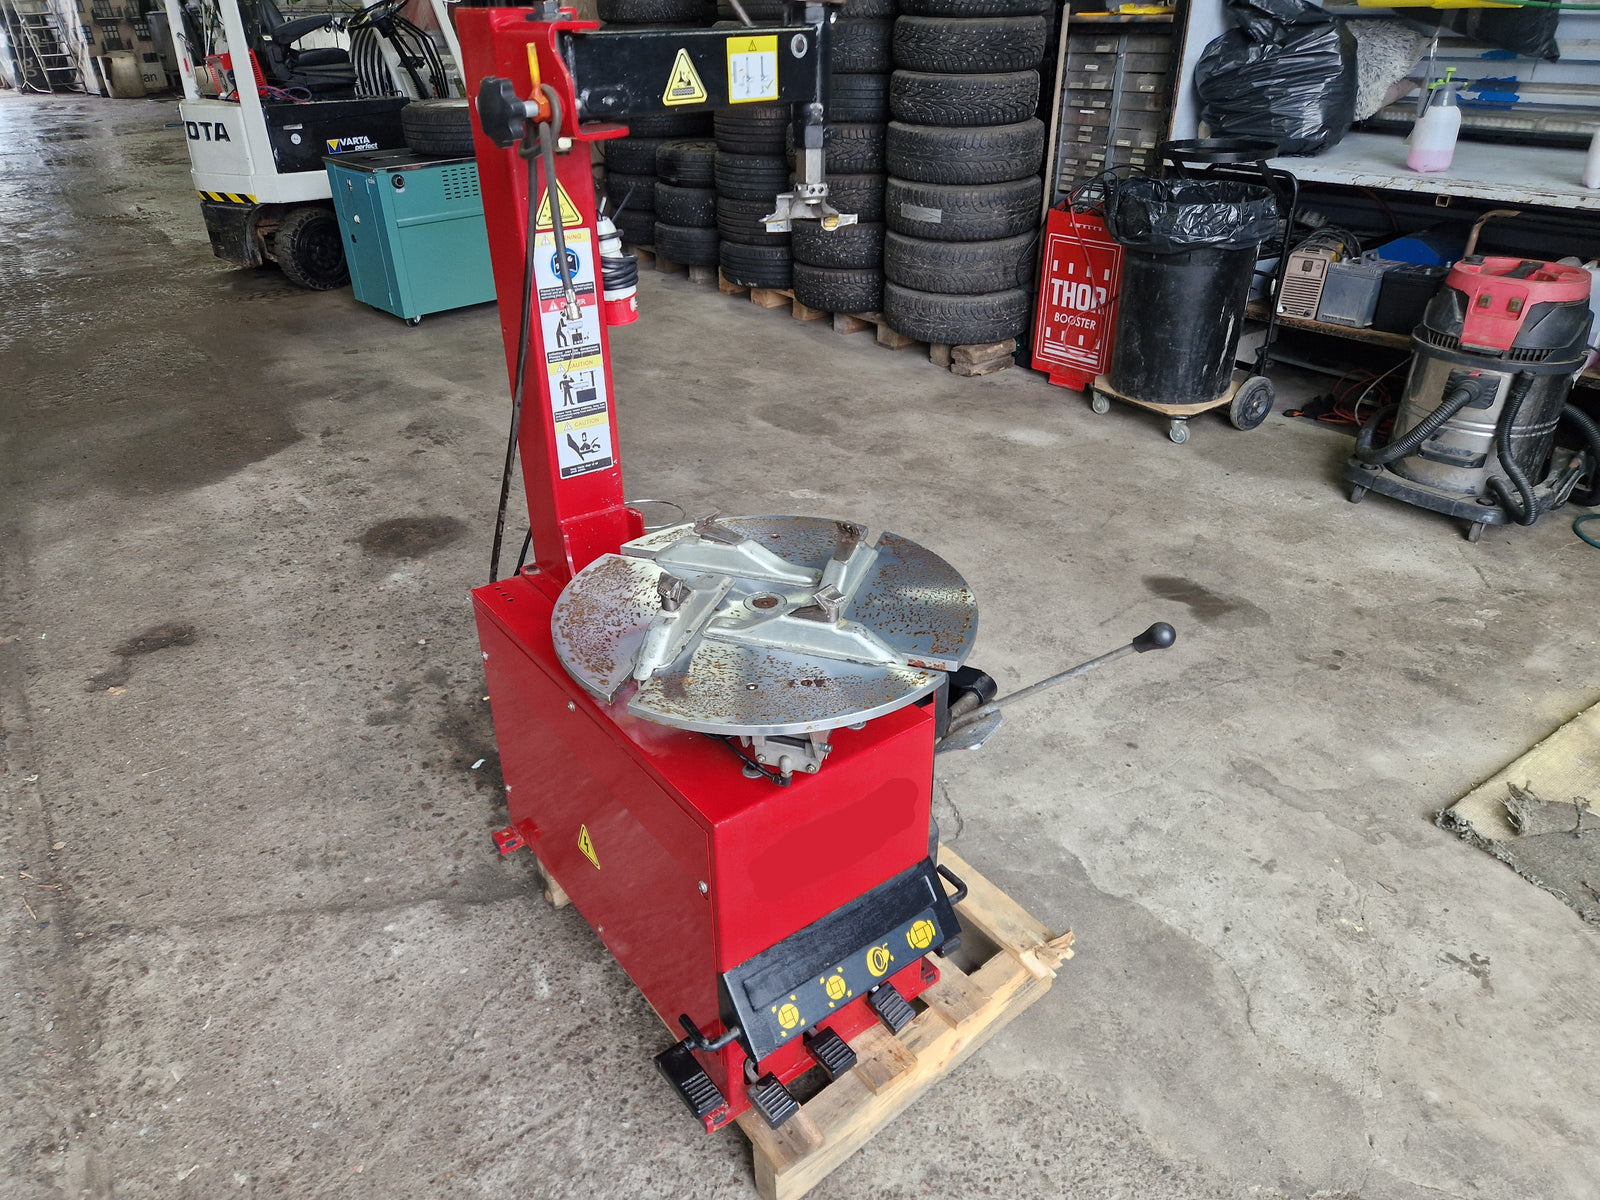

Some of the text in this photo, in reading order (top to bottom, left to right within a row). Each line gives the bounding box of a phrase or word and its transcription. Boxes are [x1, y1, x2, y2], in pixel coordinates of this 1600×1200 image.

[340, 136, 370, 146] VARTA
[354, 142, 378, 151] perfect
[1051, 278, 1107, 315] THOR
[1054, 311, 1097, 330] BOOSTER
[574, 418, 600, 428] CAUTION
